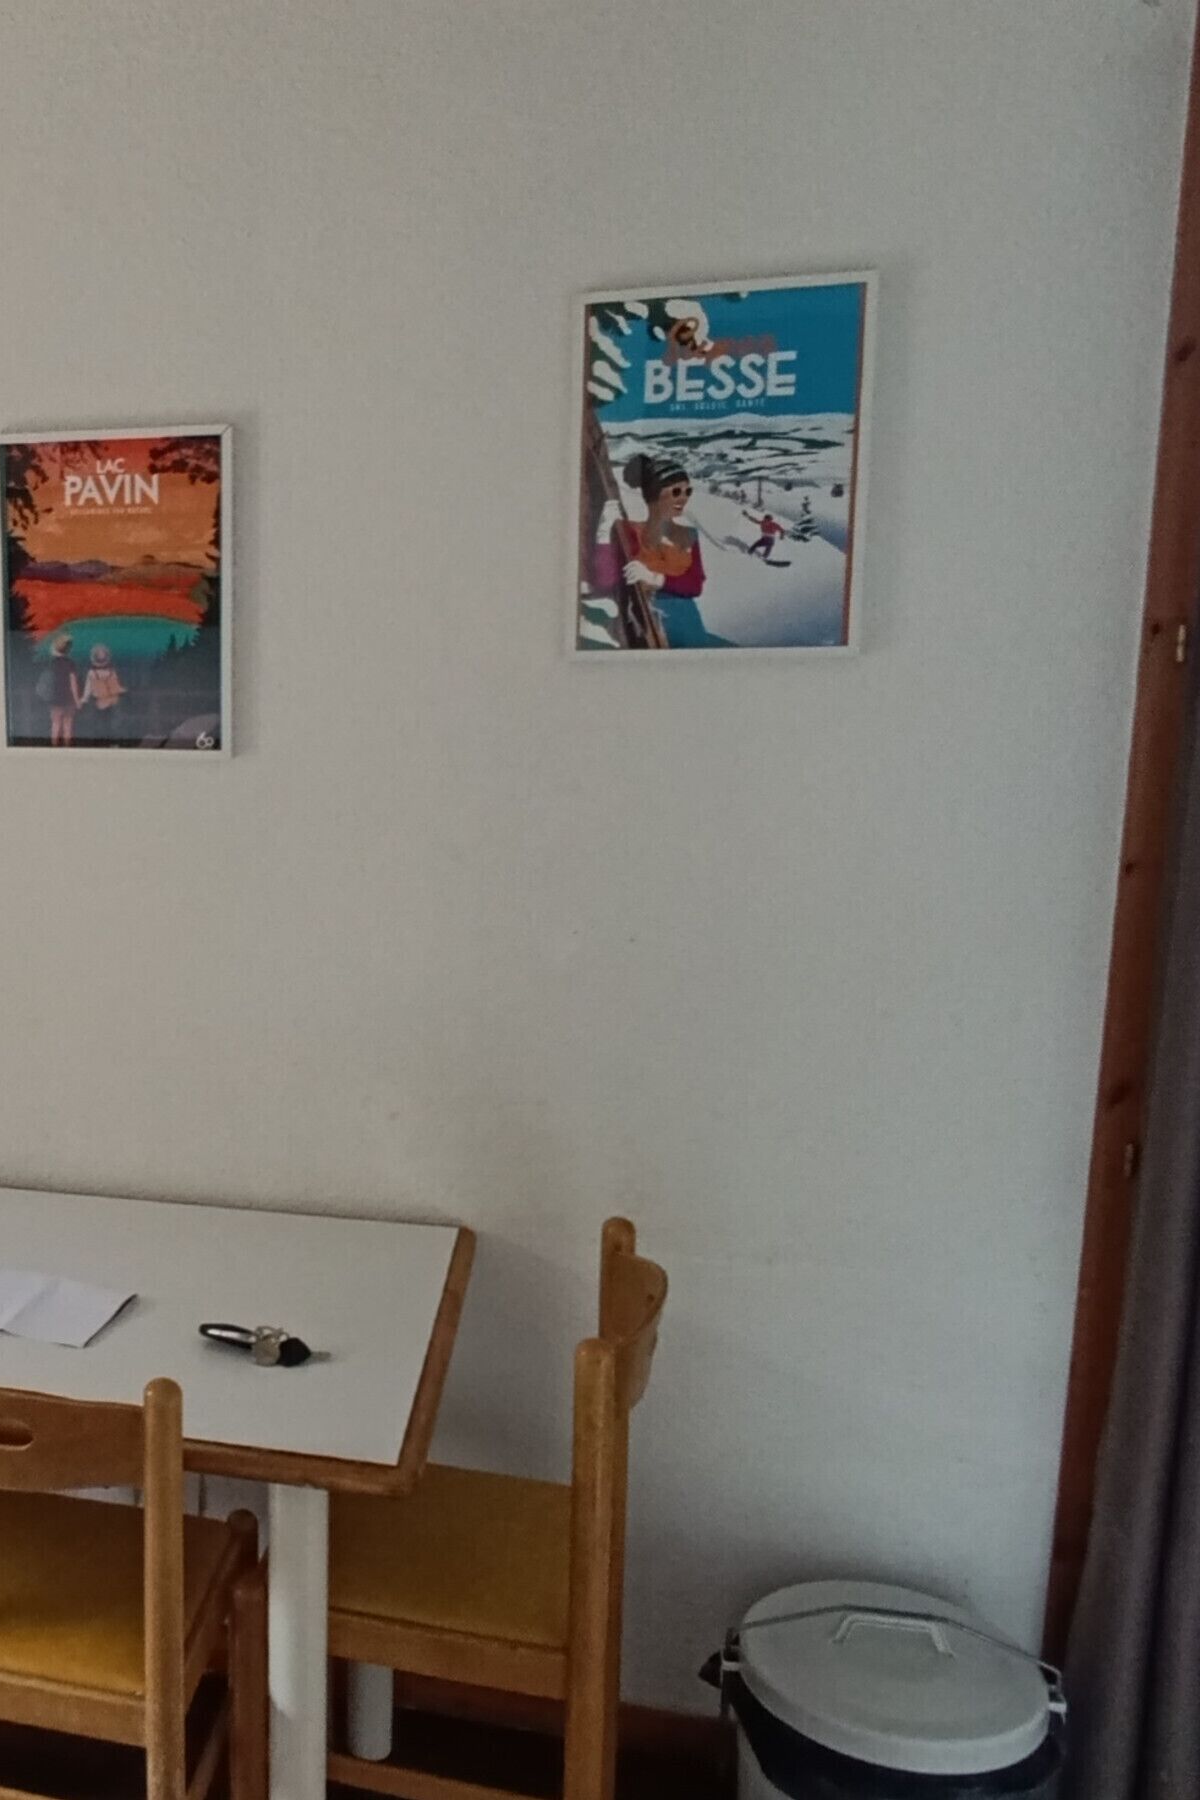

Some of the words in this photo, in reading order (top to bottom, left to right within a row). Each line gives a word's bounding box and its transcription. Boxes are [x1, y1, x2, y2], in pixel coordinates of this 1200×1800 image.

[644, 350, 798, 404] BESSE
[96, 458, 125, 474] LAC
[64, 473, 159, 506] PAVIN
